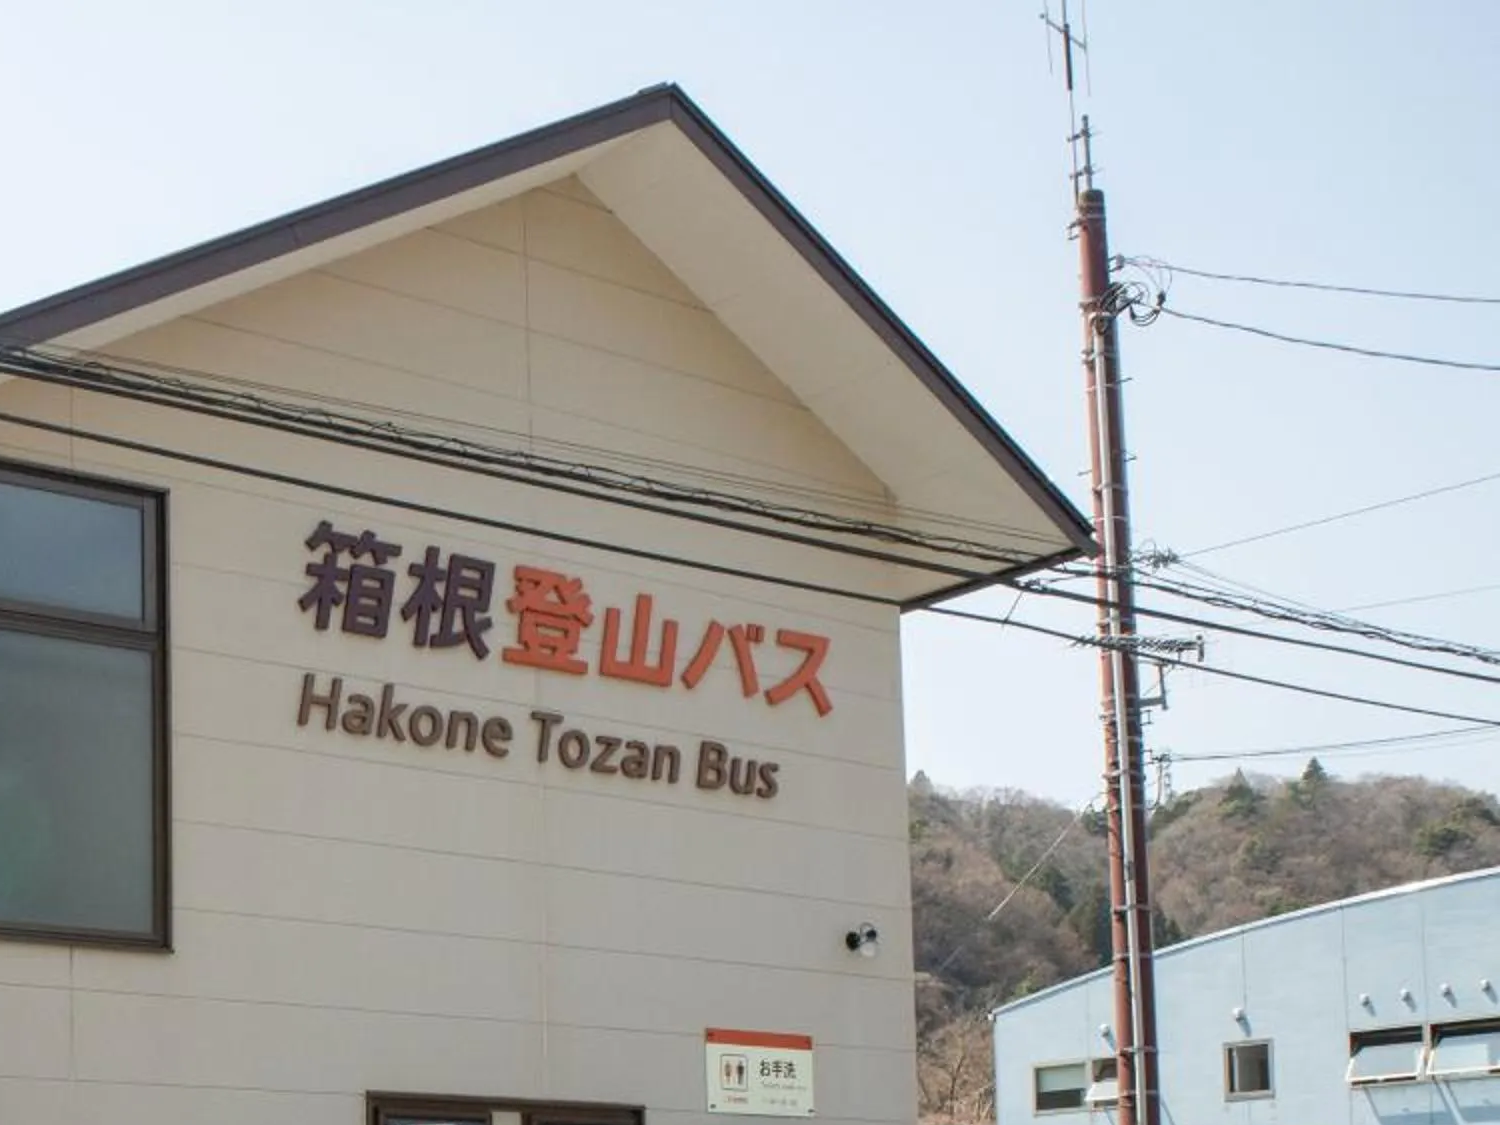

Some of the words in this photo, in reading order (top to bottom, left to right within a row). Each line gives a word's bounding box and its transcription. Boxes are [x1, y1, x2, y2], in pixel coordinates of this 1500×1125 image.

[297, 520, 833, 717] 箱根登山バス
[297, 672, 513, 758] Hakone
[530, 709, 681, 784] Tozan
[694, 739, 779, 800] Bus
[760, 1059, 797, 1079] お手洗
